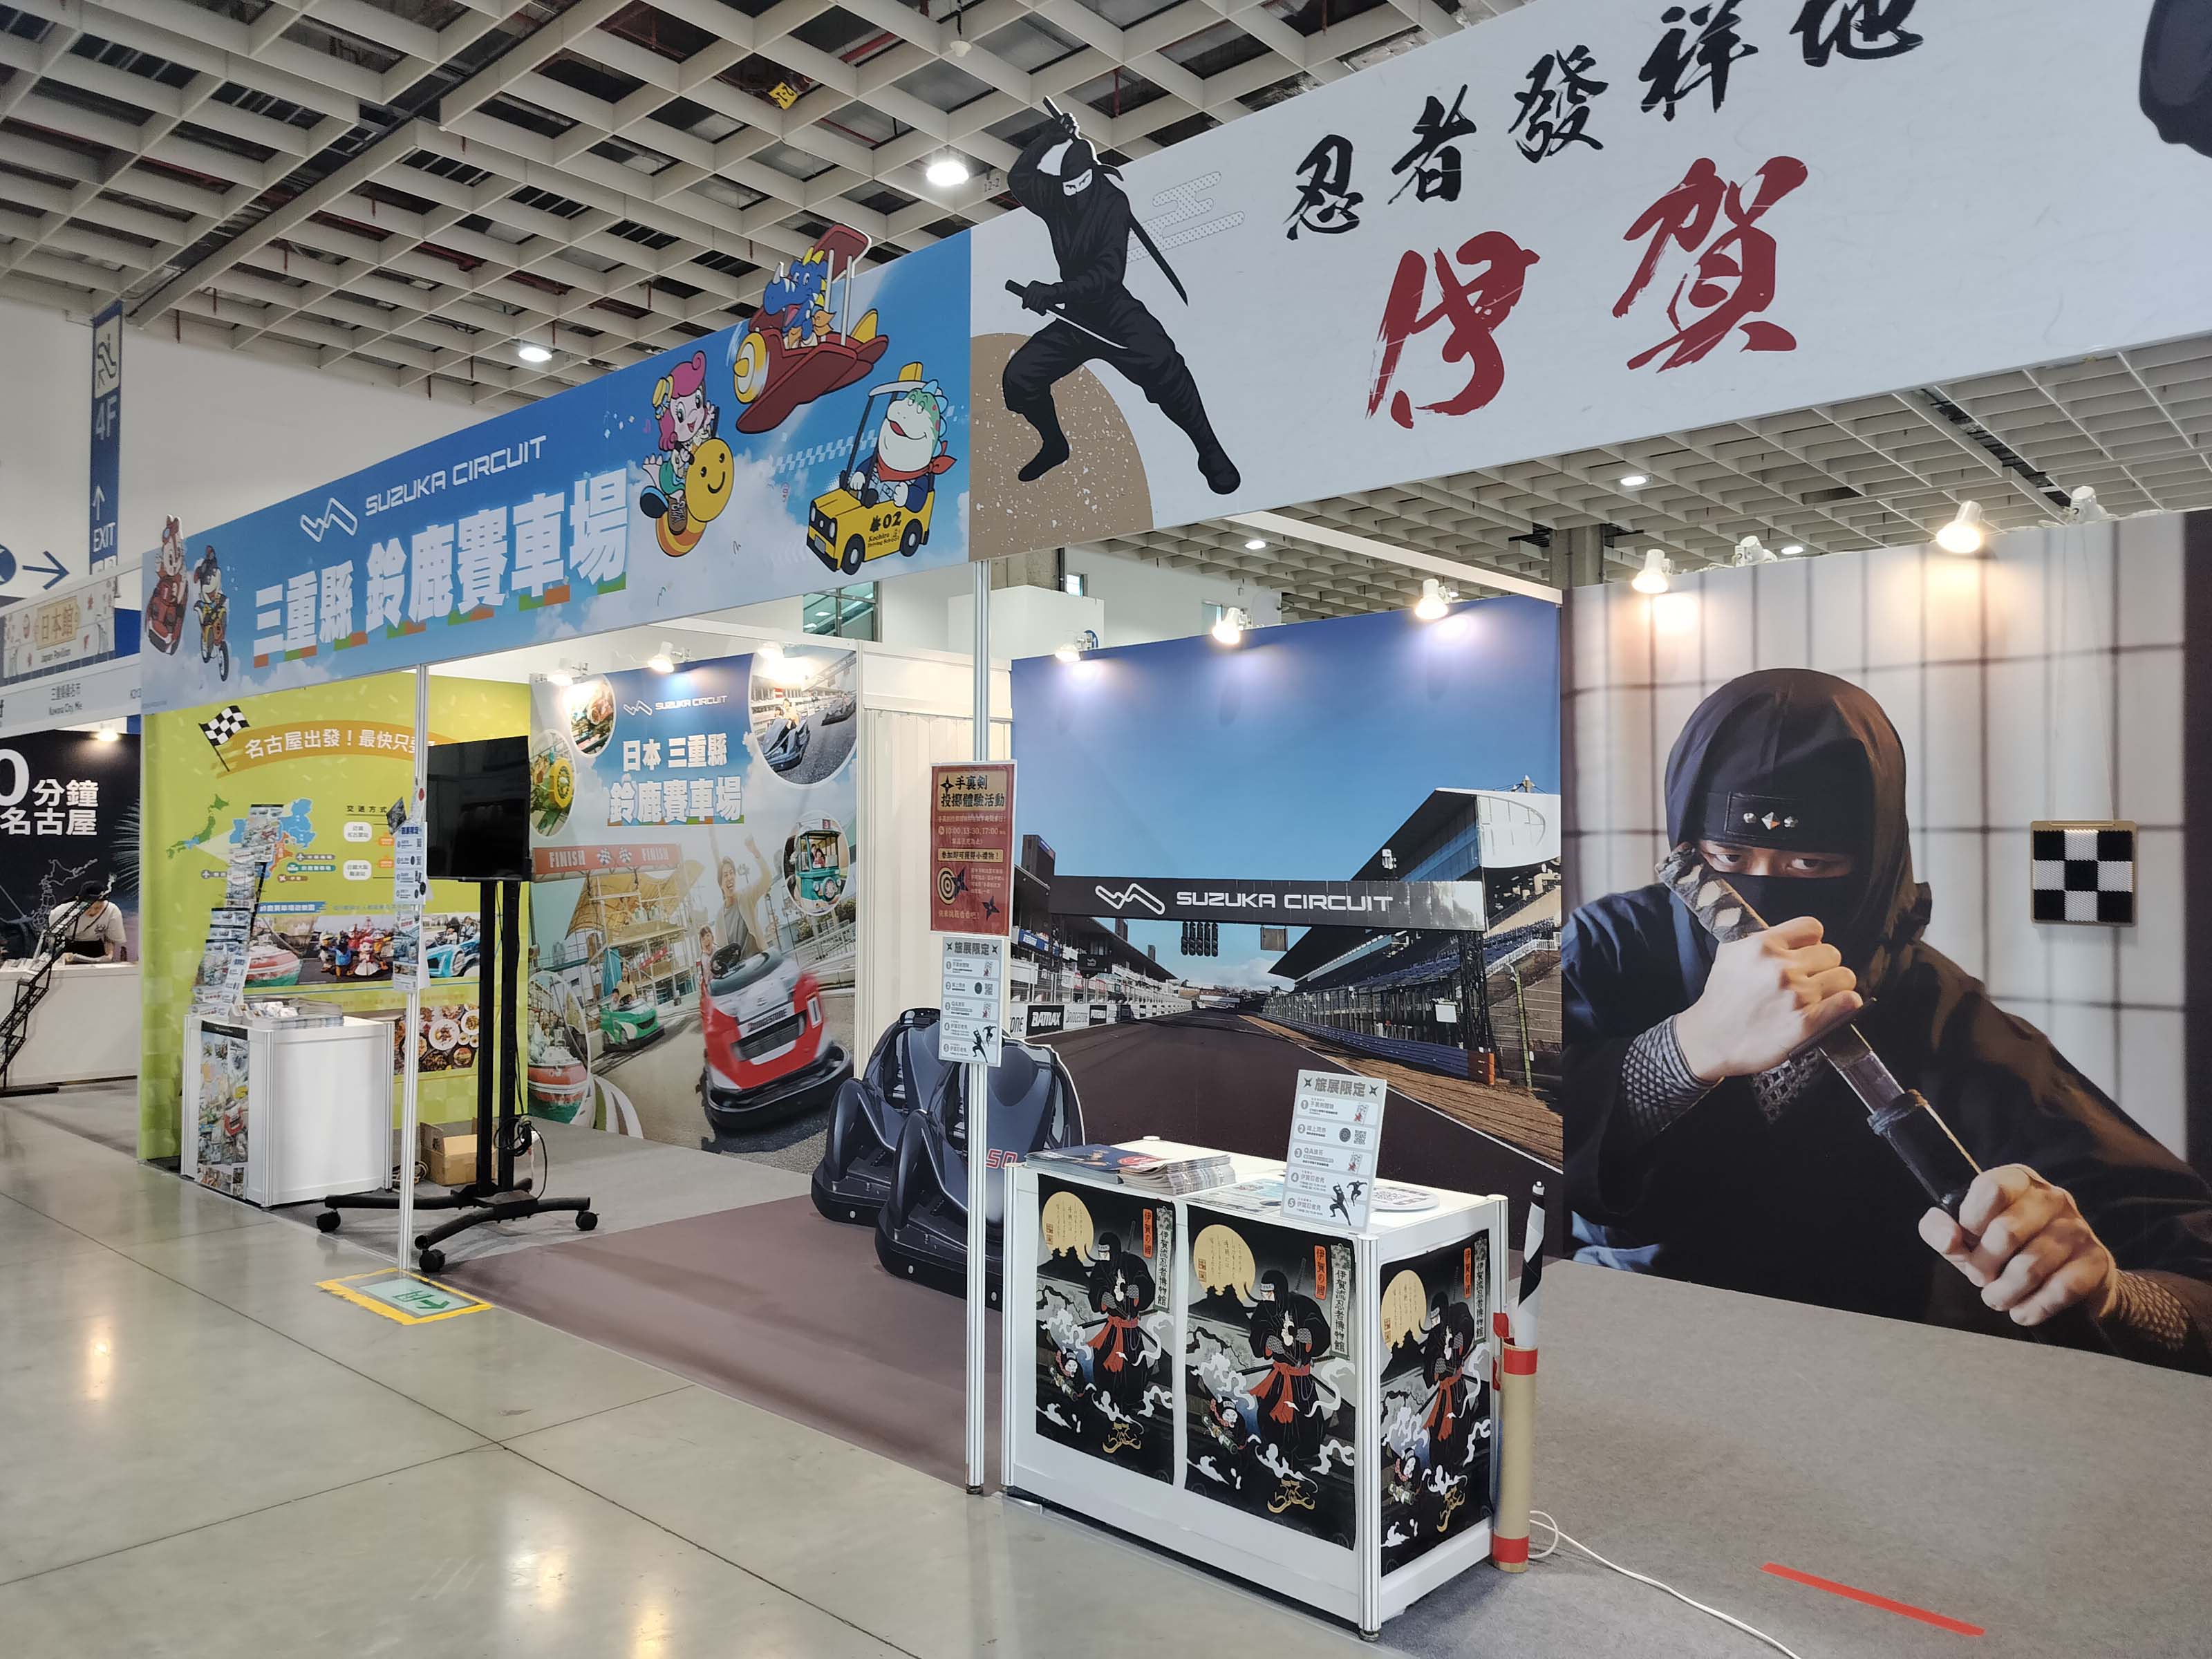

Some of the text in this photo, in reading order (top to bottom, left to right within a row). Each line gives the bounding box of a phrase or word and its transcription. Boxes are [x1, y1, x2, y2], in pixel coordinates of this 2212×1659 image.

[1367, 156, 1808, 429] 伊賀
[95, 395, 117, 440] 4F
[365, 435, 547, 516] SUZUKA CIRCUIT
[93, 522, 116, 553] EXIT
[870, 511, 902, 533] #02
[254, 468, 628, 657] 三重縣 鈴鹿賽車場
[655, 695, 728, 711] SUZUKA CIRCUIT
[623, 733, 728, 771] 日本 三重縣
[610, 776, 742, 825] 鈴鹿賽車場
[0, 807, 97, 836] 名古屋
[549, 847, 669, 868] FINISH FINISH
[1177, 891, 1394, 912] SUZUKA CIRCUIT
[955, 941, 989, 955] 旅展限定
[1314, 1077, 1366, 1097] 旅展限定
[1333, 1269, 1347, 1352] 伊賀流忍者博物館
